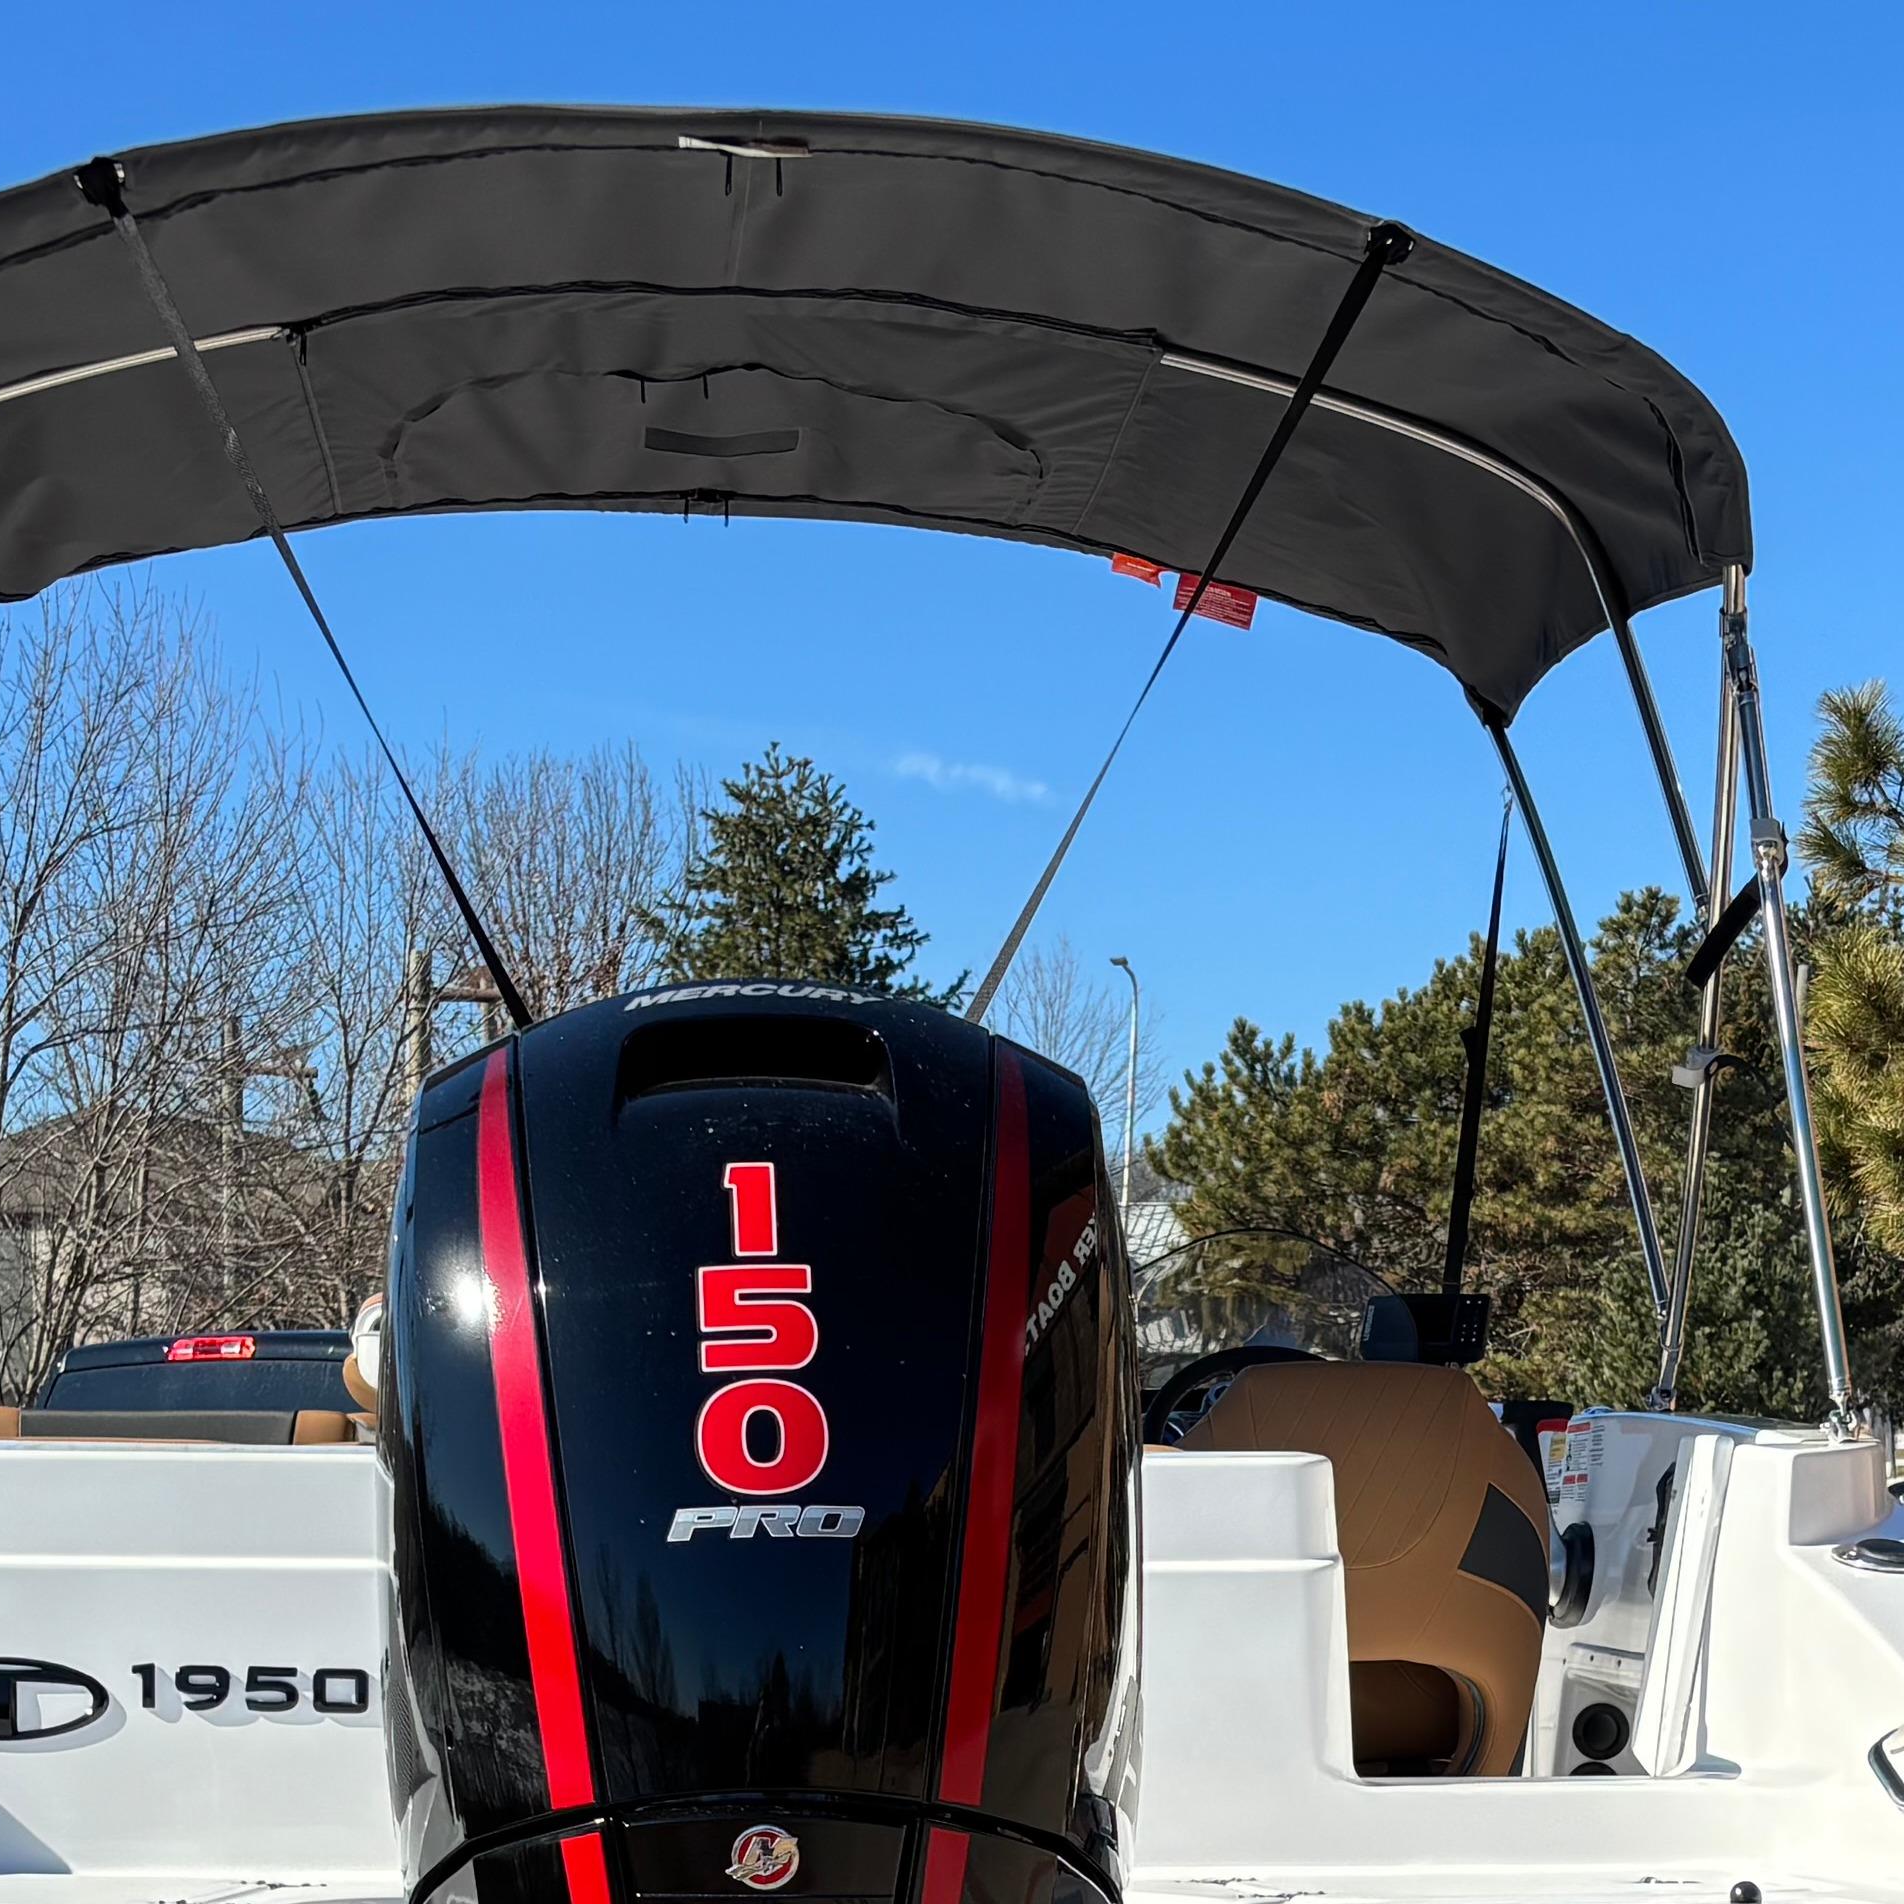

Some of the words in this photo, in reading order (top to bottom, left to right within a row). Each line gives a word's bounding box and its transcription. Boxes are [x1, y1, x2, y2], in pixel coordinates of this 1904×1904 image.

[623, 983, 886, 1011] MERCURY
[698, 1161, 829, 1496] 150
[667, 1504, 866, 1542] PRO
[132, 1662, 369, 1714] 1950
